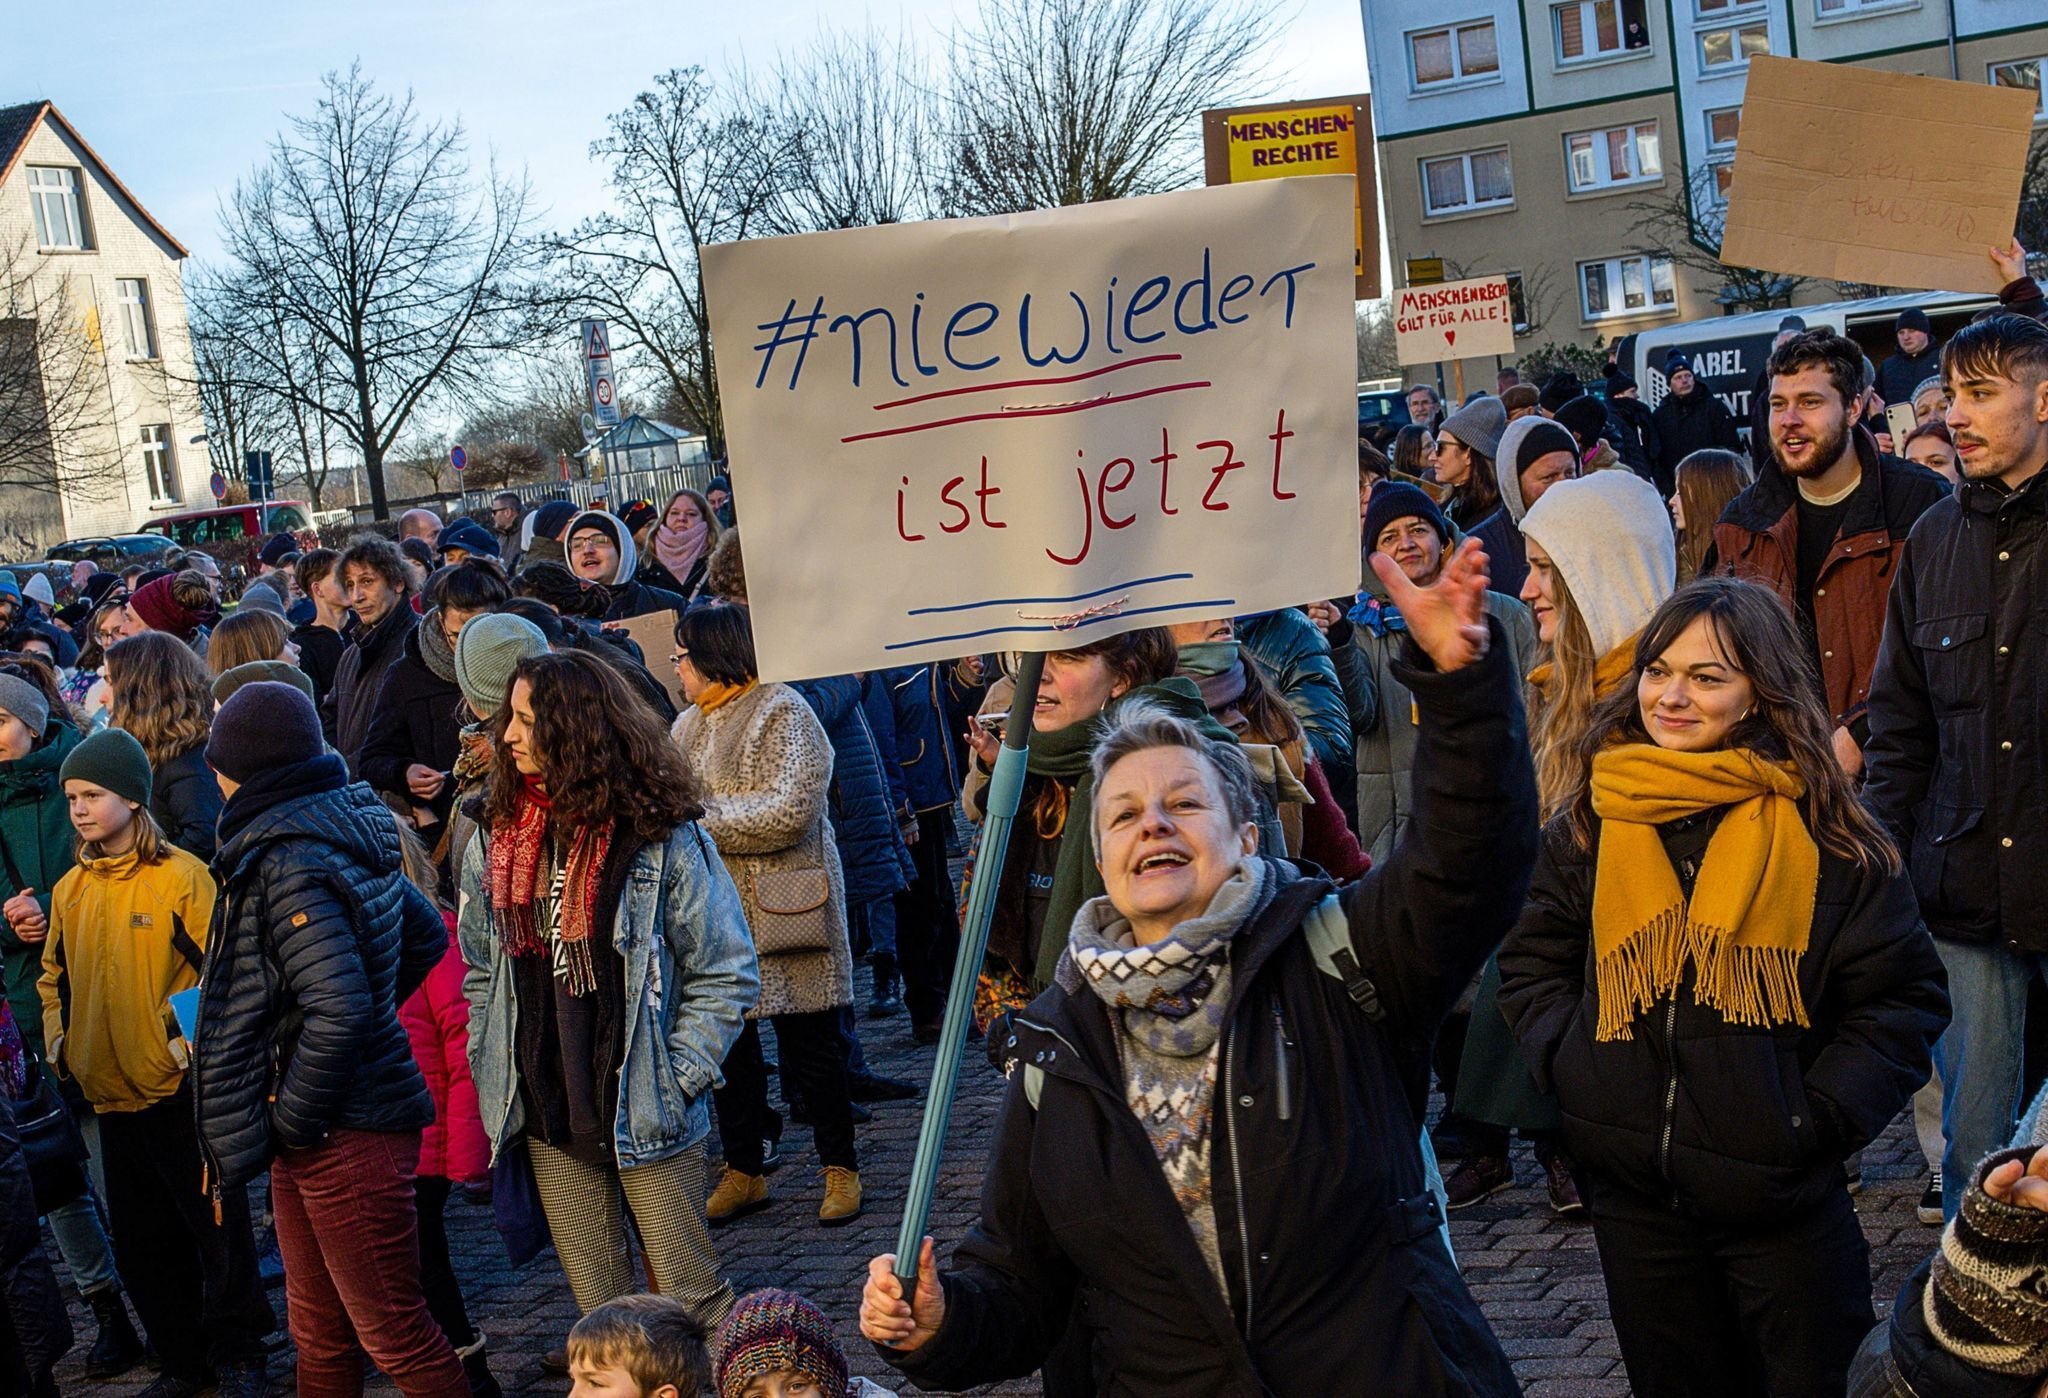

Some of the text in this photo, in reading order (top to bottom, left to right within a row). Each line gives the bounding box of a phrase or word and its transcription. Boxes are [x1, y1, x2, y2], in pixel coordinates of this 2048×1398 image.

[1230, 114, 1355, 143] MENSCHEN-
[1252, 141, 1340, 167] RECHTE
[1396, 315, 1424, 333] GILT
[1430, 308, 1456, 328] FÜR
[1682, 349, 1747, 377] ABEL
[599, 385, 609, 399] 30
[896, 409, 1297, 566] ist jetzt
